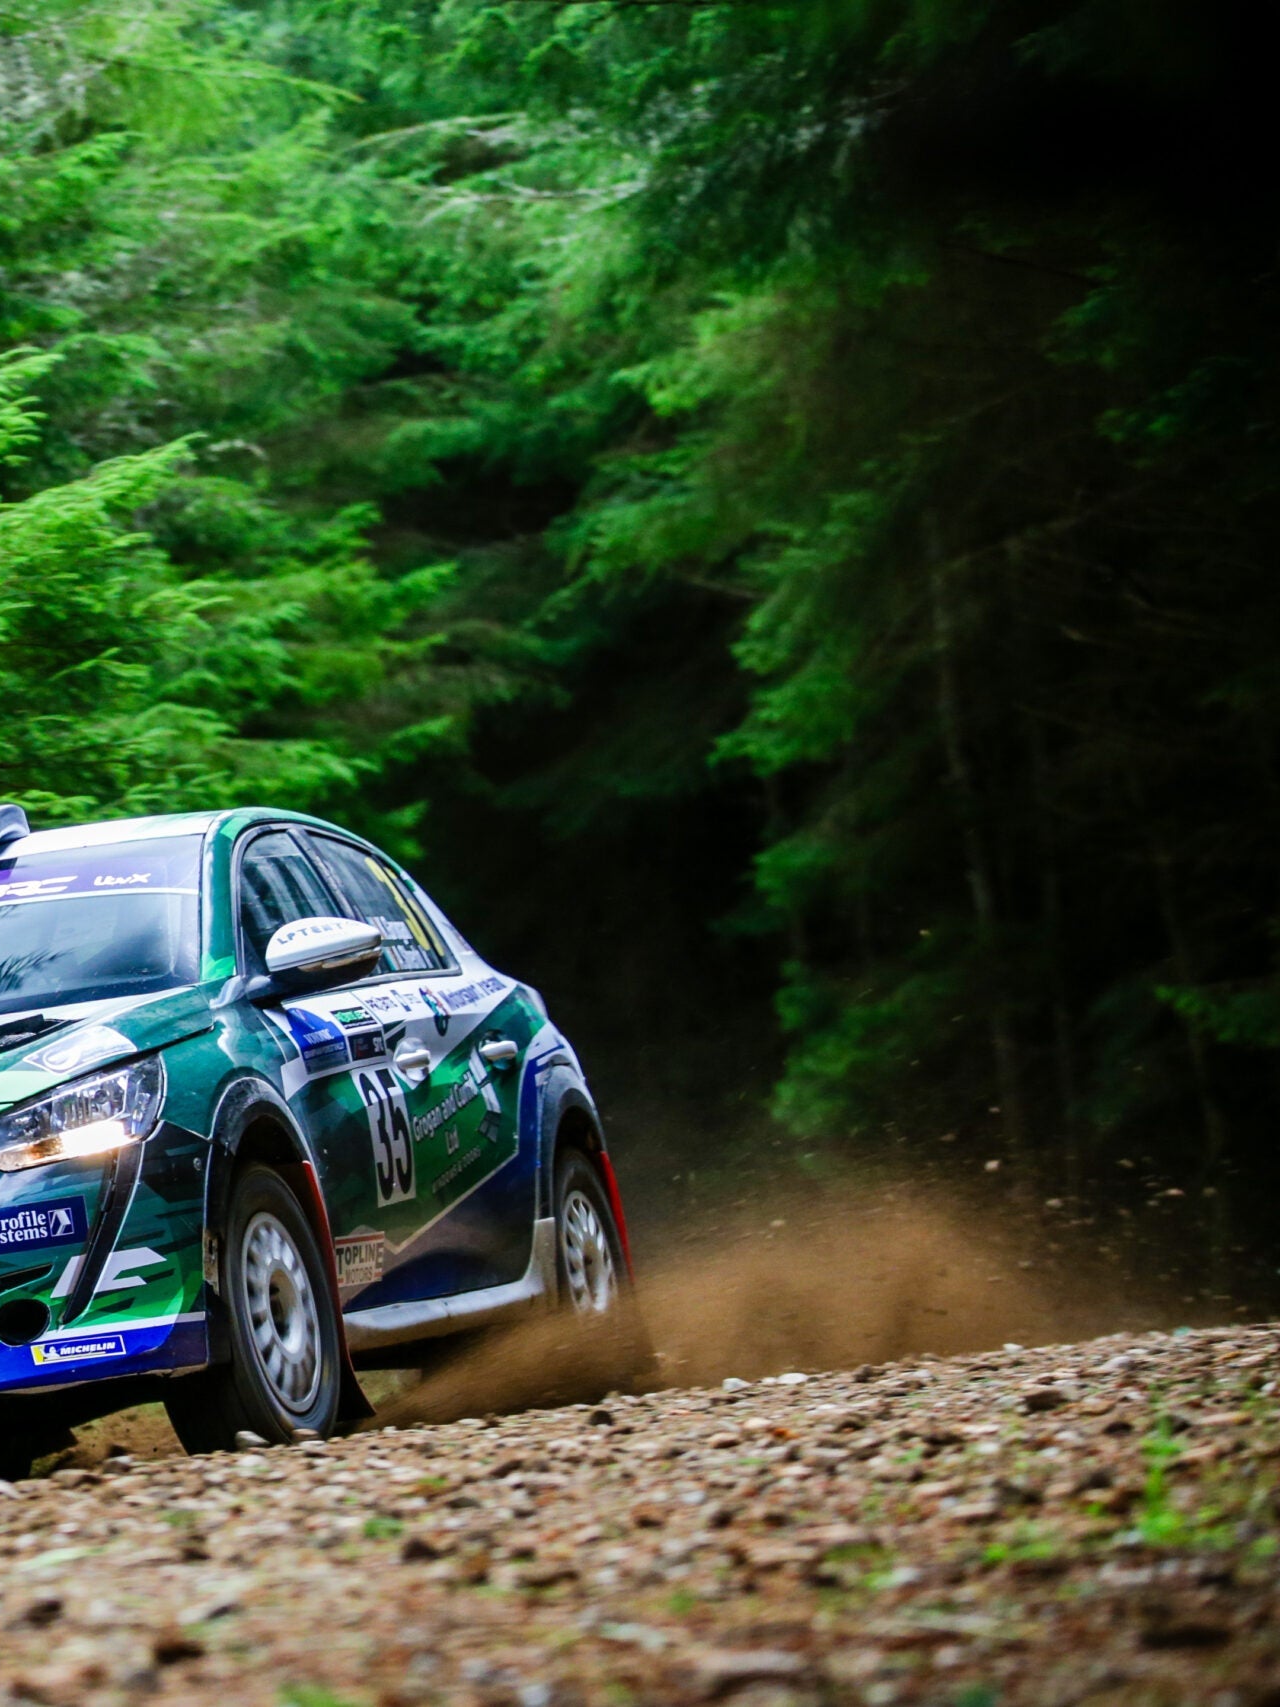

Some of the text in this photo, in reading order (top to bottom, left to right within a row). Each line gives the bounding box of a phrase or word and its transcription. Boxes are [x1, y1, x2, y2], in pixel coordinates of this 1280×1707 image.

[359, 1068, 412, 1201] 35
[412, 1105, 444, 1142] Grogan
[441, 1085, 458, 1121] and
[335, 1242, 385, 1275] TOPLINE
[59, 1341, 116, 1356] MICHELIN
